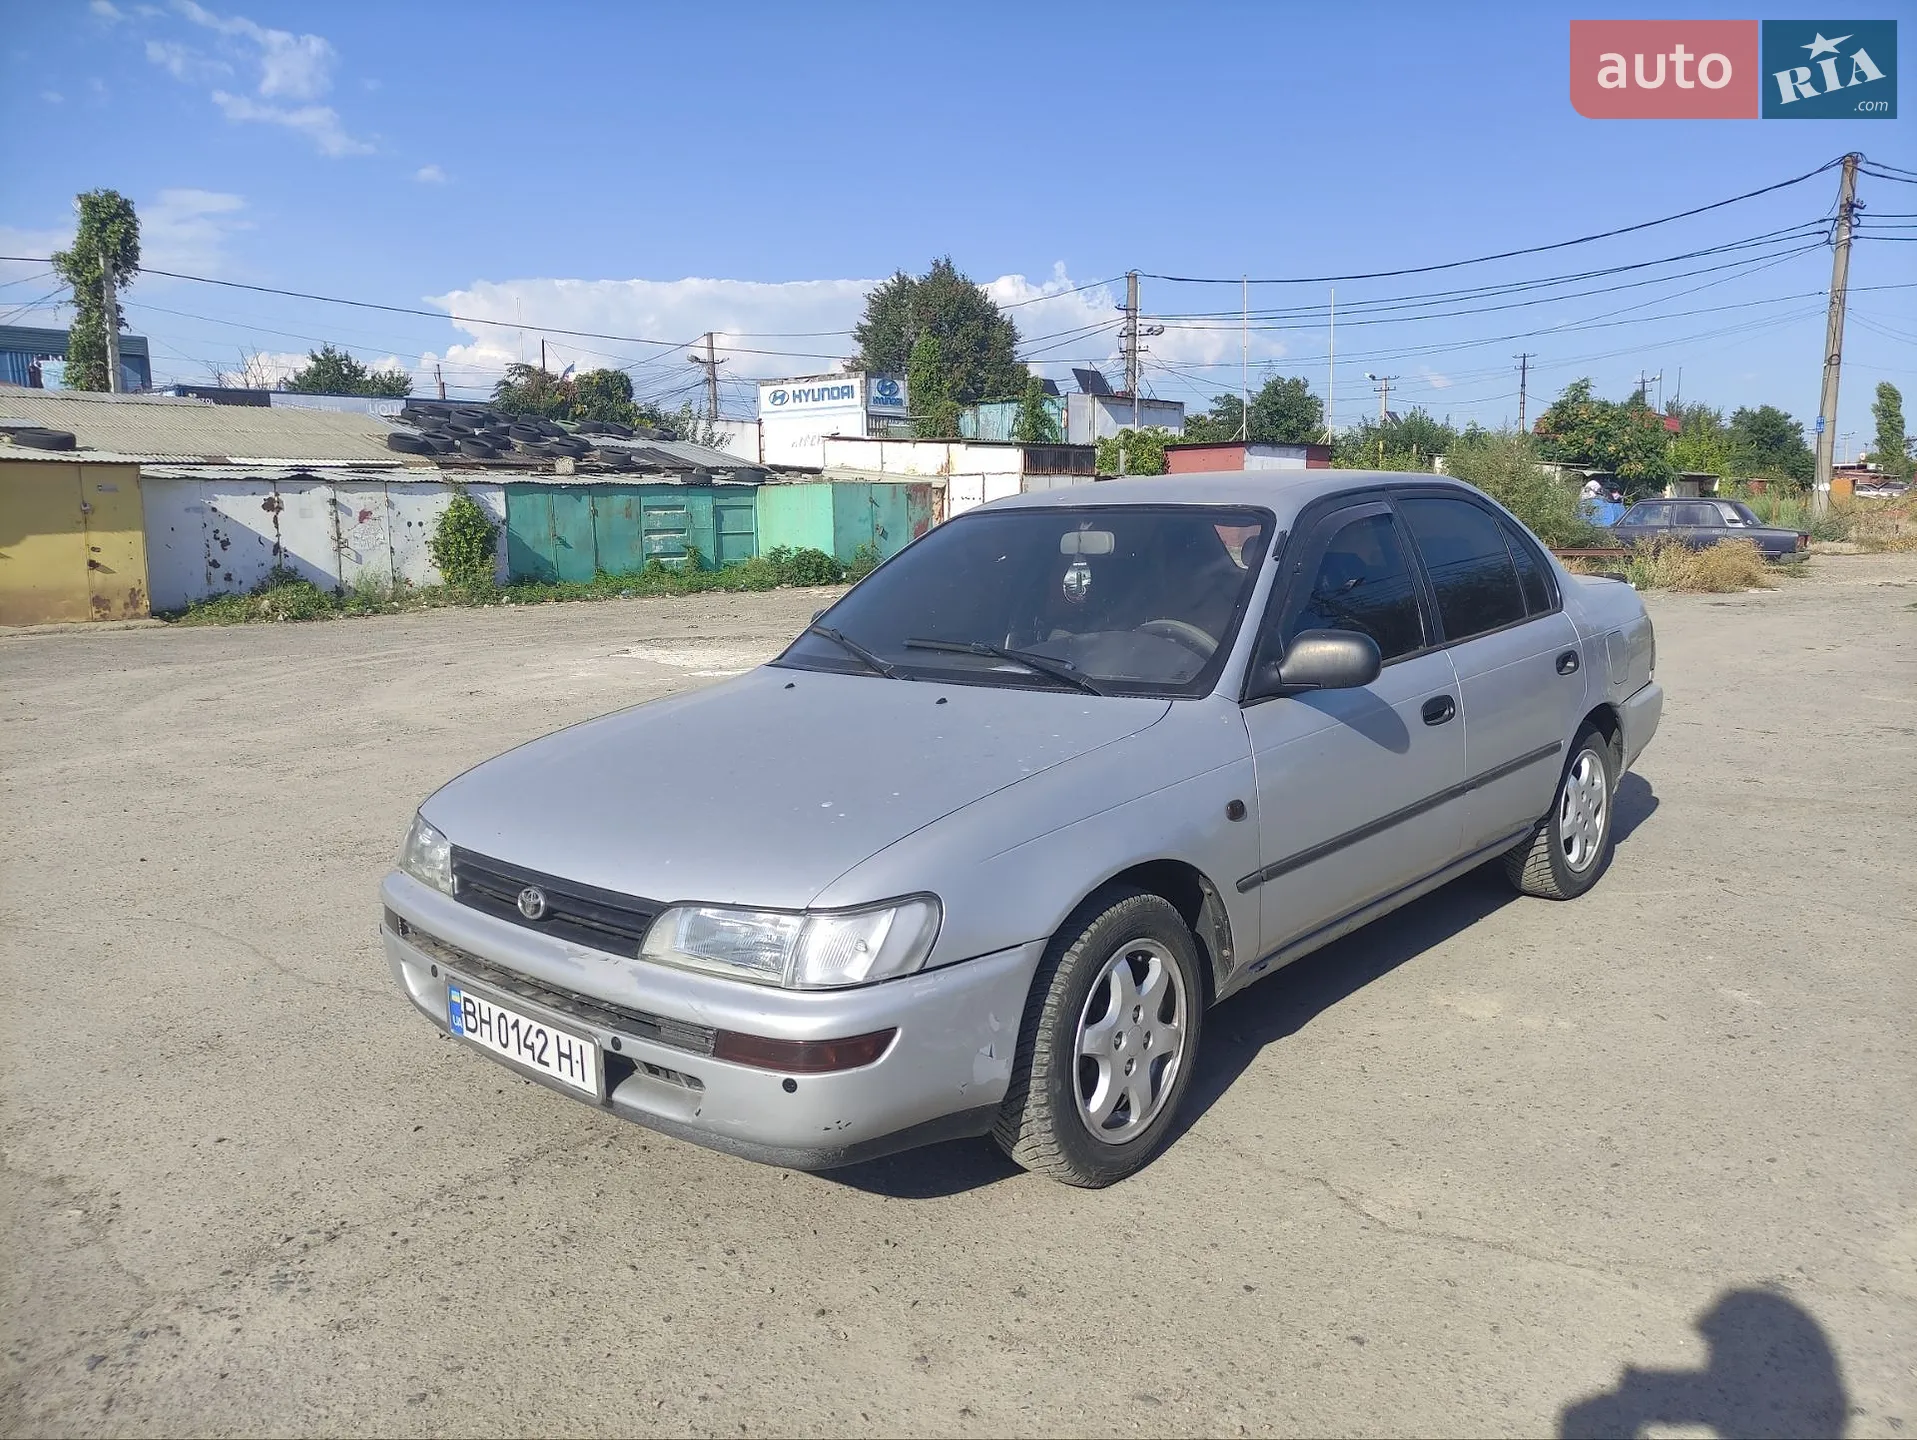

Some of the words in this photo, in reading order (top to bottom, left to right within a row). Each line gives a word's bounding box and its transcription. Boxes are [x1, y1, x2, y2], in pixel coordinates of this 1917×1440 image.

[792, 384, 855, 404] HYUNDAI
[452, 1014, 463, 1028] UA
[463, 996, 493, 1042] BH
[497, 1012, 550, 1067] 0142
[556, 1034, 585, 1082] HI
